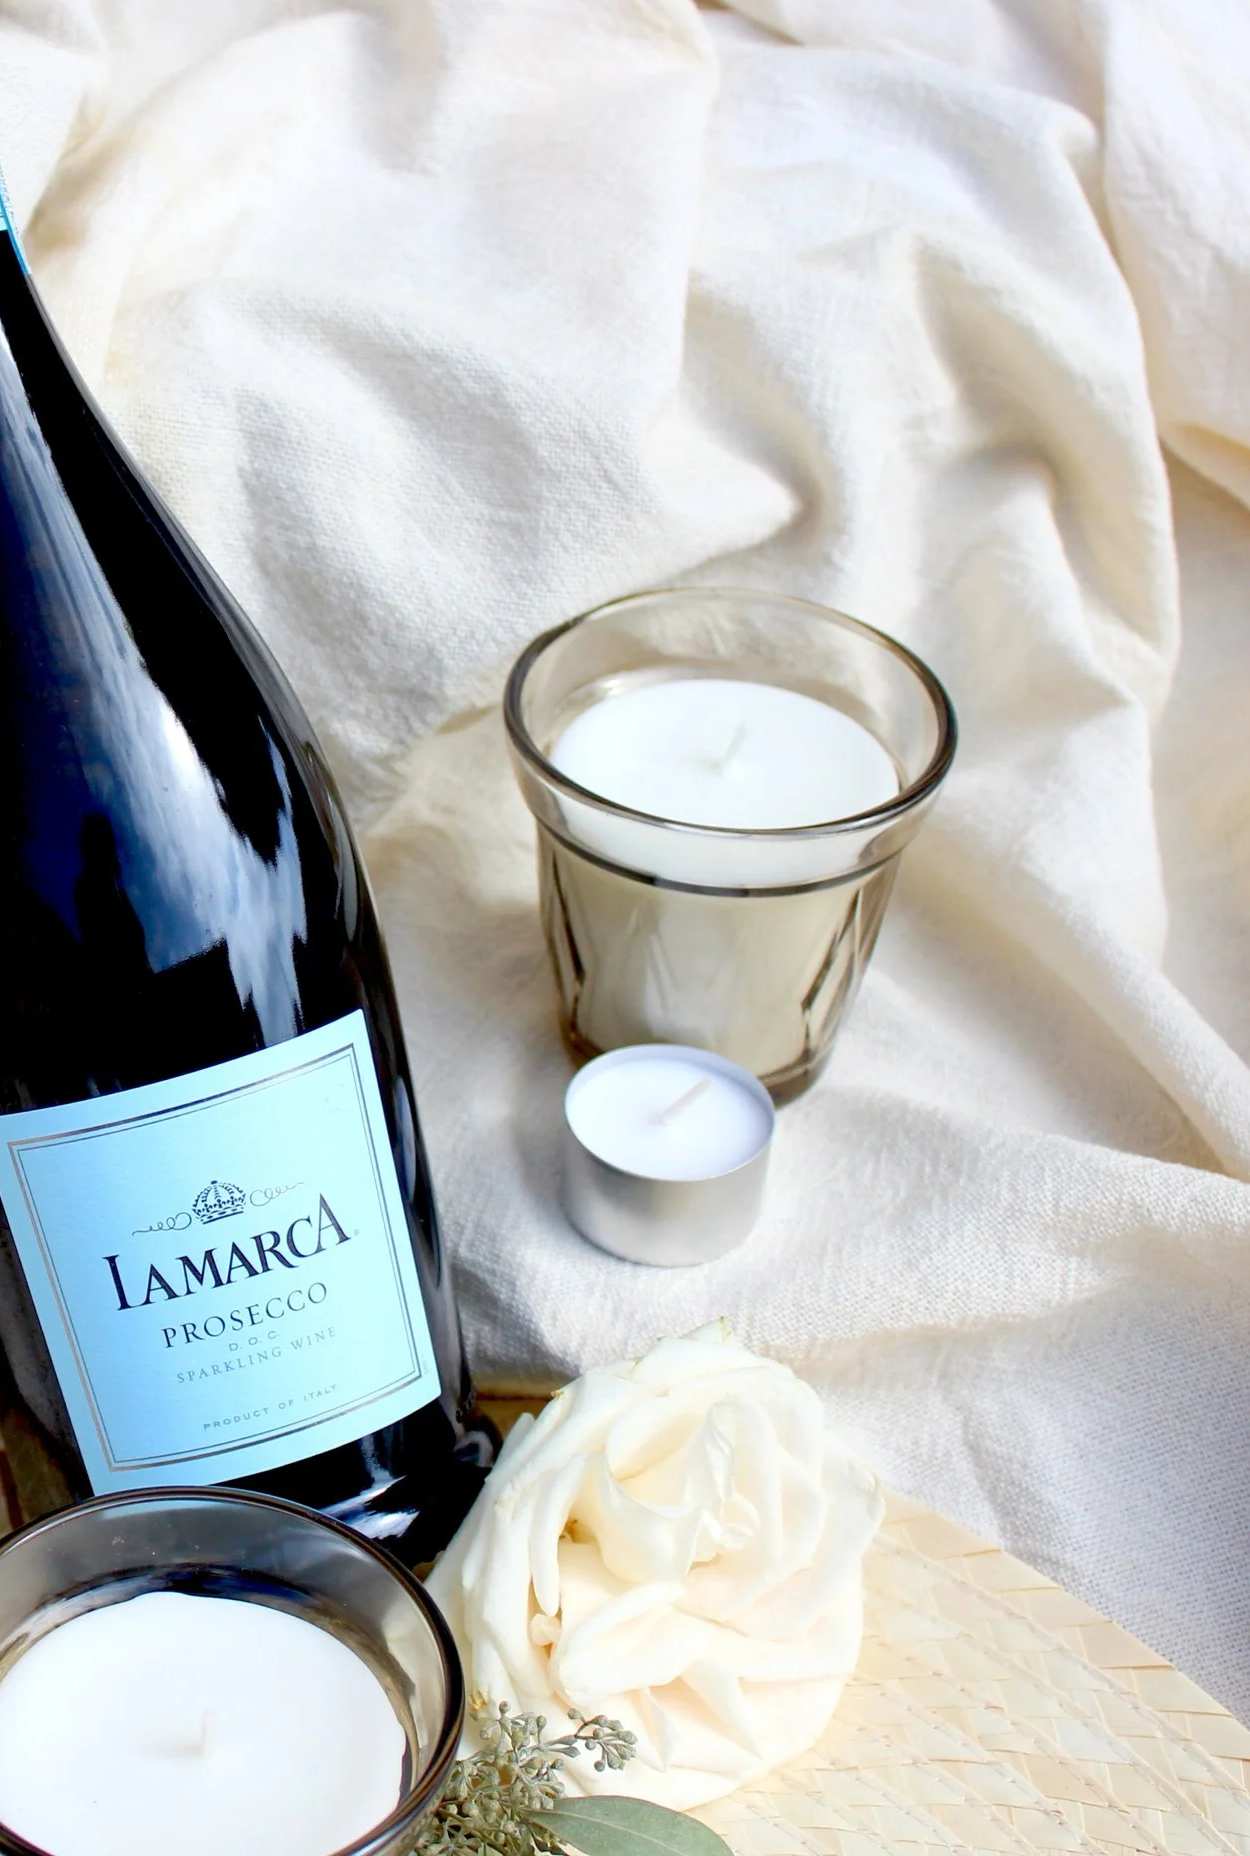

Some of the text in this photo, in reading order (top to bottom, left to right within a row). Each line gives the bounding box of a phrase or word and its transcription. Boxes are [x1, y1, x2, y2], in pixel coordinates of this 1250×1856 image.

[162, 1282, 328, 1349] PROSECCO
[176, 1326, 337, 1384] SPARKLING WINE
[202, 1384, 338, 1432] PRODUCT OF ITALY
